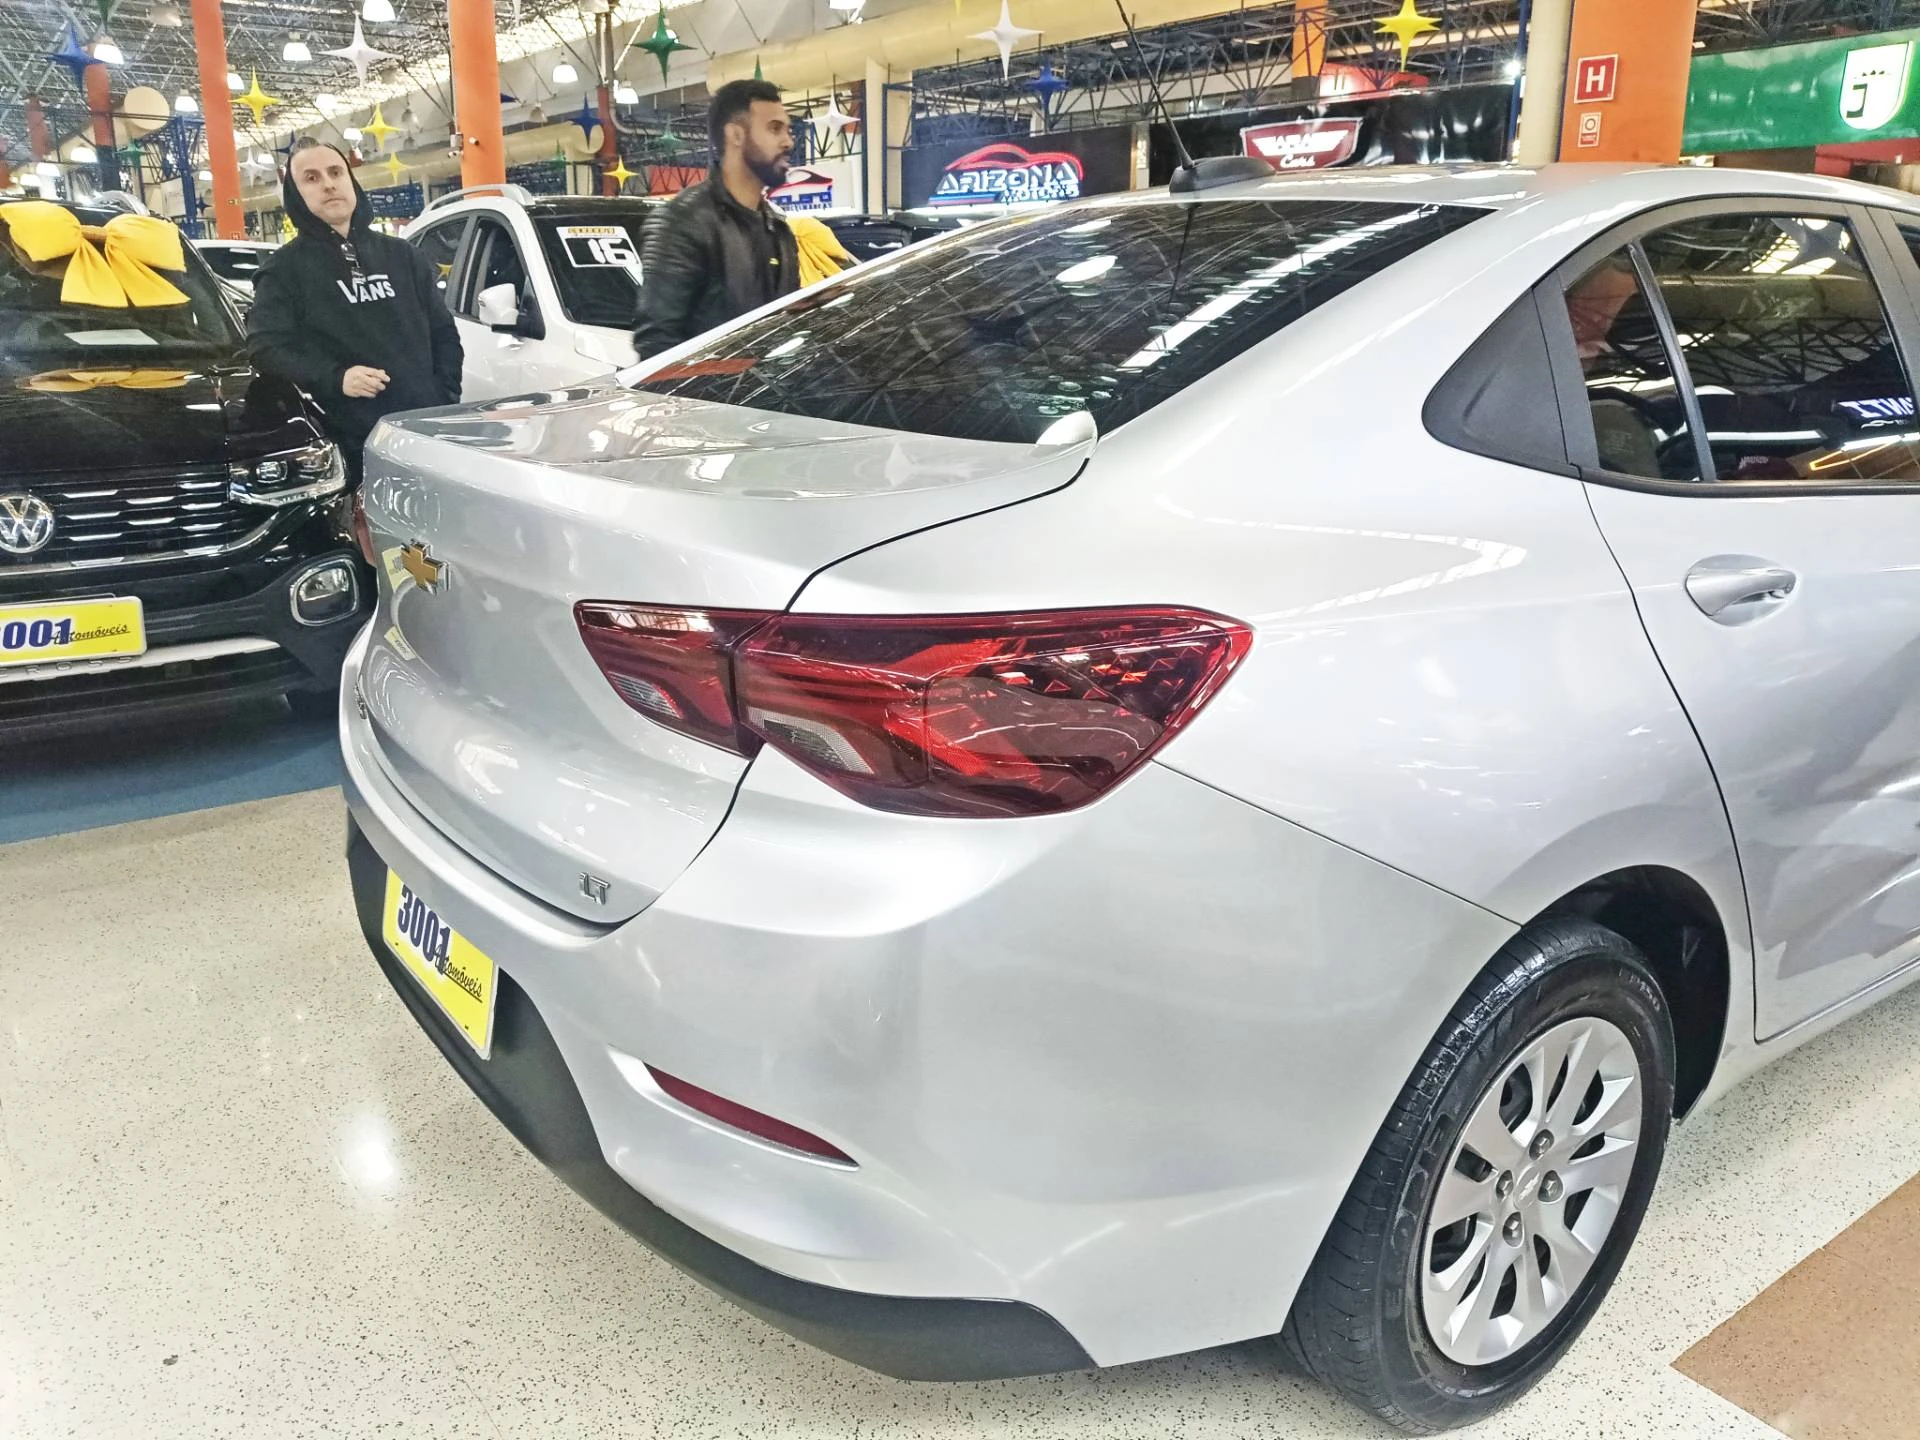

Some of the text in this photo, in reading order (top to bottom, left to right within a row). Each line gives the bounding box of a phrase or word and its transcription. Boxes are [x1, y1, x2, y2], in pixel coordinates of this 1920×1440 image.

[1585, 64, 1607, 93] H
[934, 161, 1079, 195] ARIZONA
[336, 274, 396, 303] VANS
[0, 618, 72, 649] 001
[579, 871, 611, 905] LT
[397, 884, 451, 975] 3001
